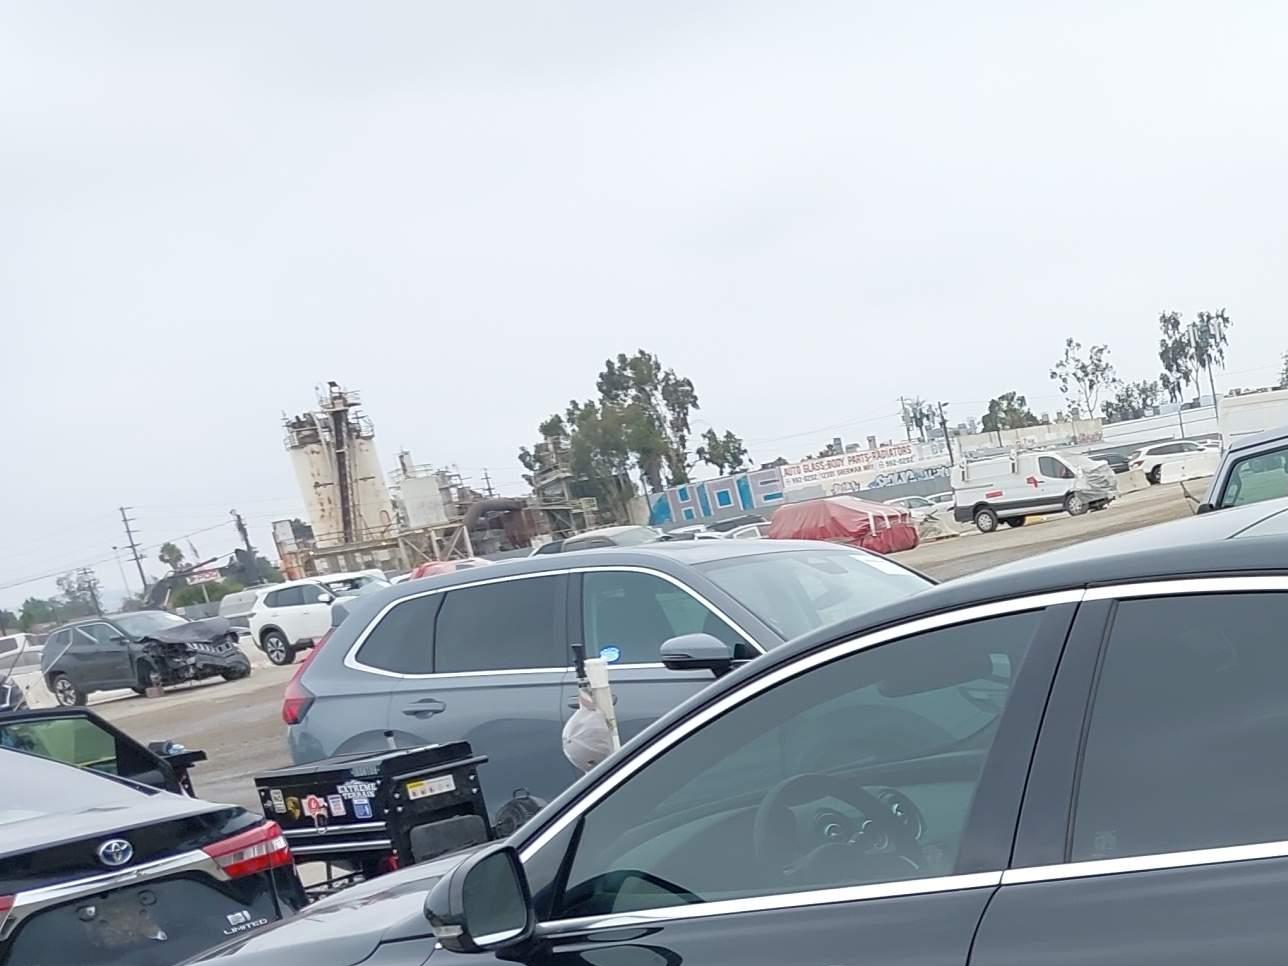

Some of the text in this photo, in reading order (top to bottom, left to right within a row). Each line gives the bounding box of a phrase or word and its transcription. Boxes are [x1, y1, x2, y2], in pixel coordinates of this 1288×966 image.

[783, 465, 801, 476] AUTO
[337, 782, 377, 793] EXTREME
[342, 791, 376, 800] TERRAIN
[223, 918, 268, 935] LIMITED
